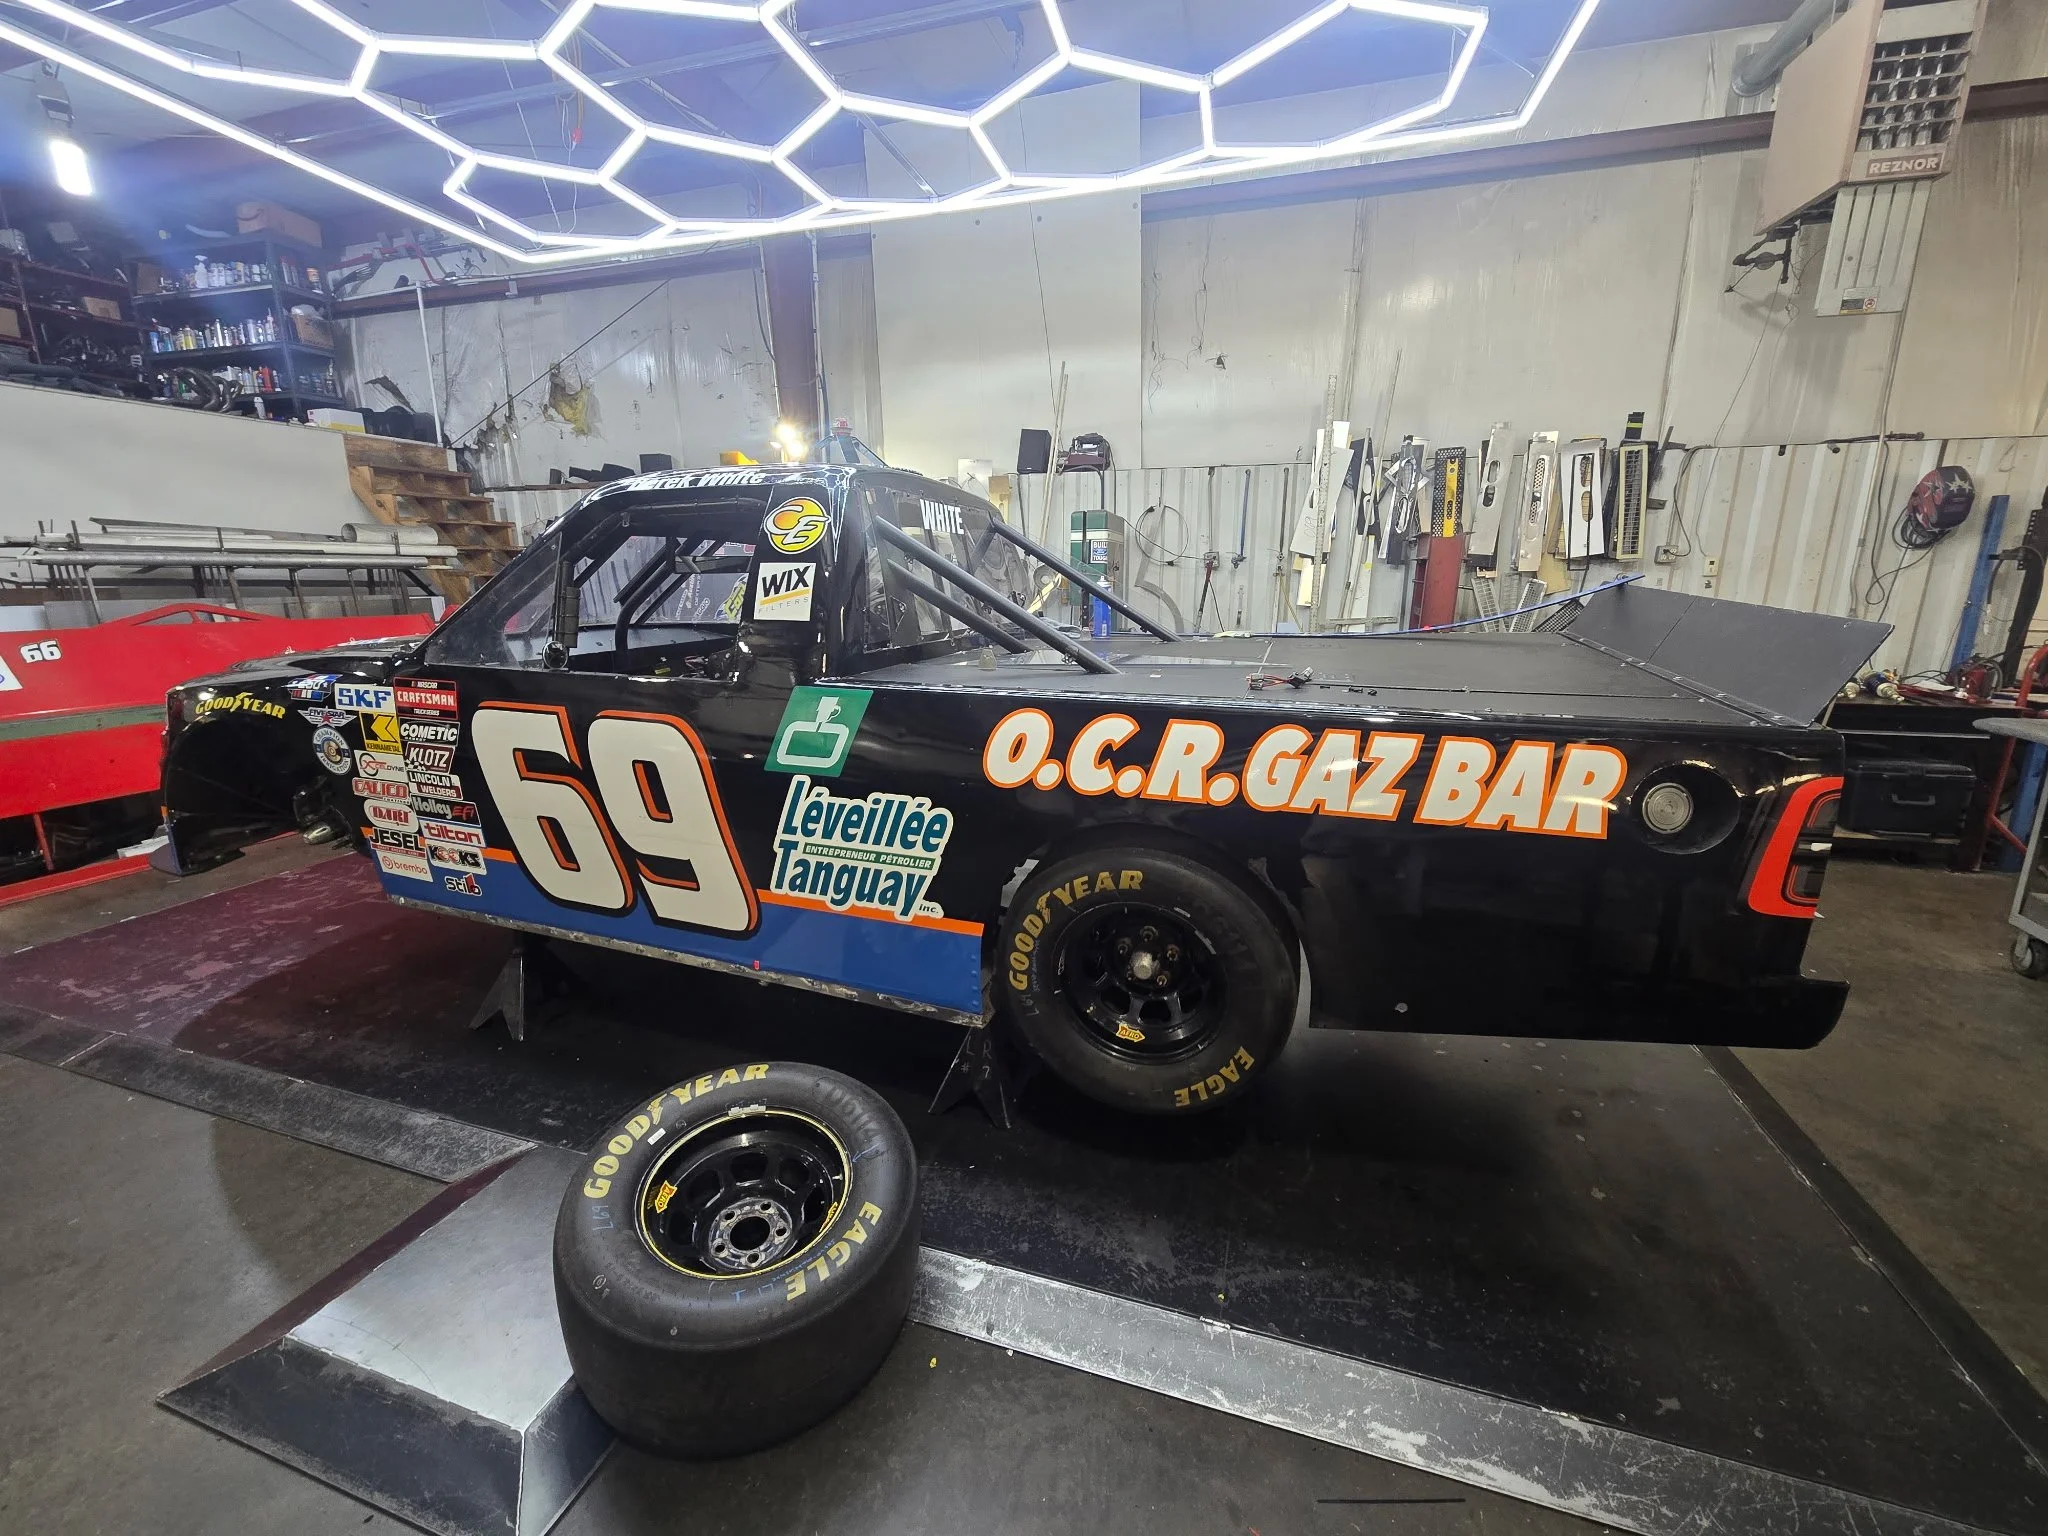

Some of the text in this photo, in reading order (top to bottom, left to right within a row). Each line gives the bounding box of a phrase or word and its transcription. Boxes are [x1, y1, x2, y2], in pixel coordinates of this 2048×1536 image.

[1869, 156, 1939, 174] REZNOR
[697, 470, 766, 487] White
[920, 499, 964, 534] WHITE
[762, 565, 810, 598] WIX
[758, 597, 809, 613] FILTERS
[20, 640, 62, 663] 66
[417, 681, 438, 689] NASCAR
[195, 692, 285, 719] GOODYEAR
[338, 688, 391, 708] SKF
[397, 690, 455, 706] CRAFTSMAN
[400, 723, 458, 741] COMETIC
[366, 743, 402, 753] KENNAMETAL
[409, 748, 450, 768] KLOTZ
[354, 779, 409, 798] CALICO
[409, 772, 451, 786] LINCOLN
[1241, 724, 1424, 821] GAZ
[1413, 736, 1627, 839] BAR
[420, 785, 457, 797] WELDERS
[412, 796, 453, 819] Holley
[471, 702, 757, 932] 69
[781, 780, 948, 853] Léveillée
[369, 827, 425, 852] JESEL
[424, 823, 481, 844] tilton
[393, 860, 427, 875] brembo
[427, 843, 482, 869] KOOKS
[805, 845, 932, 869] ENTREPRENEUR PÉTROLIER
[445, 873, 482, 896] Stilo
[774, 840, 927, 917] Tanguay
[918, 903, 939, 914] inc.
[1009, 870, 1143, 991] GOODYEAR
[1120, 1029, 1140, 1039] AERO
[1174, 1046, 1255, 1107] EAGLE
[584, 1064, 769, 1200] GOODYEAR
[657, 1185, 673, 1208] AERO
[786, 1201, 883, 1301] EAGLE
